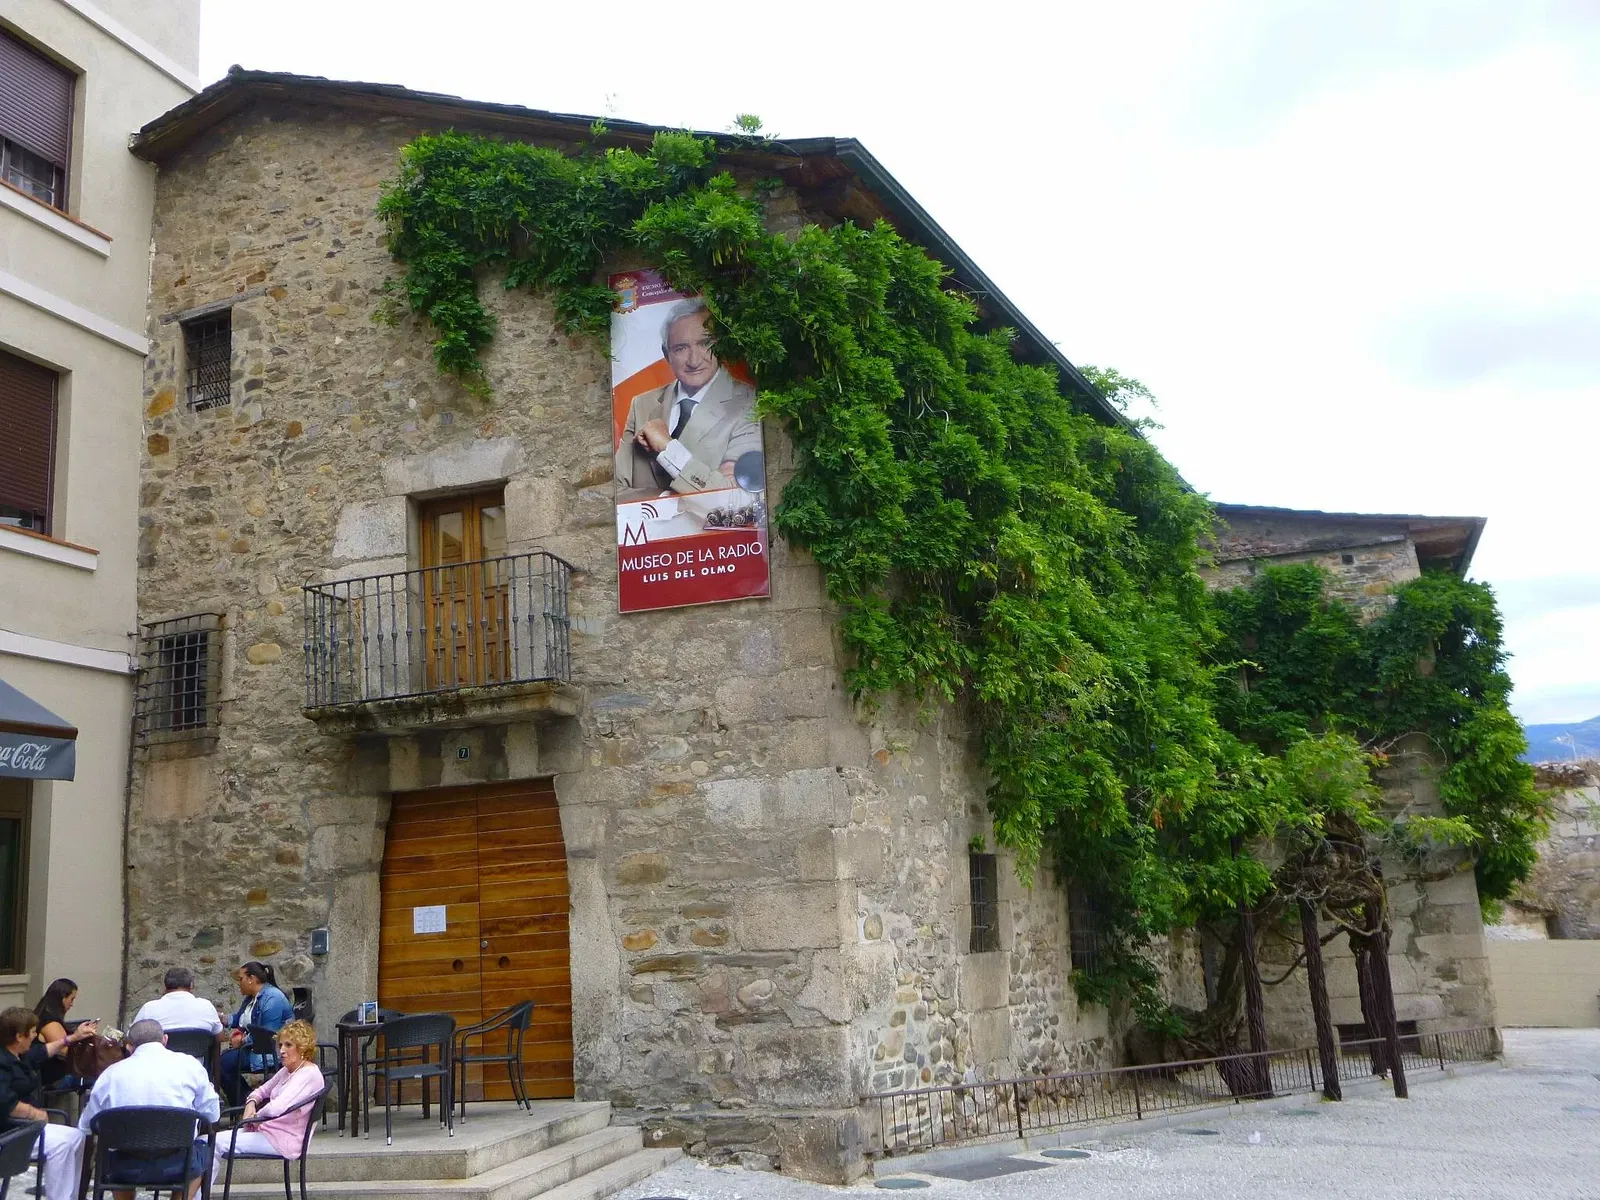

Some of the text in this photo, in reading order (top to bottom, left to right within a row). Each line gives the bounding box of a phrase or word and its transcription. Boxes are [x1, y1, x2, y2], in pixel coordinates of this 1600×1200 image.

[621, 541, 763, 572] MUSEO DE LA RADIO
[643, 564, 736, 583] LUIS DEL OLMO
